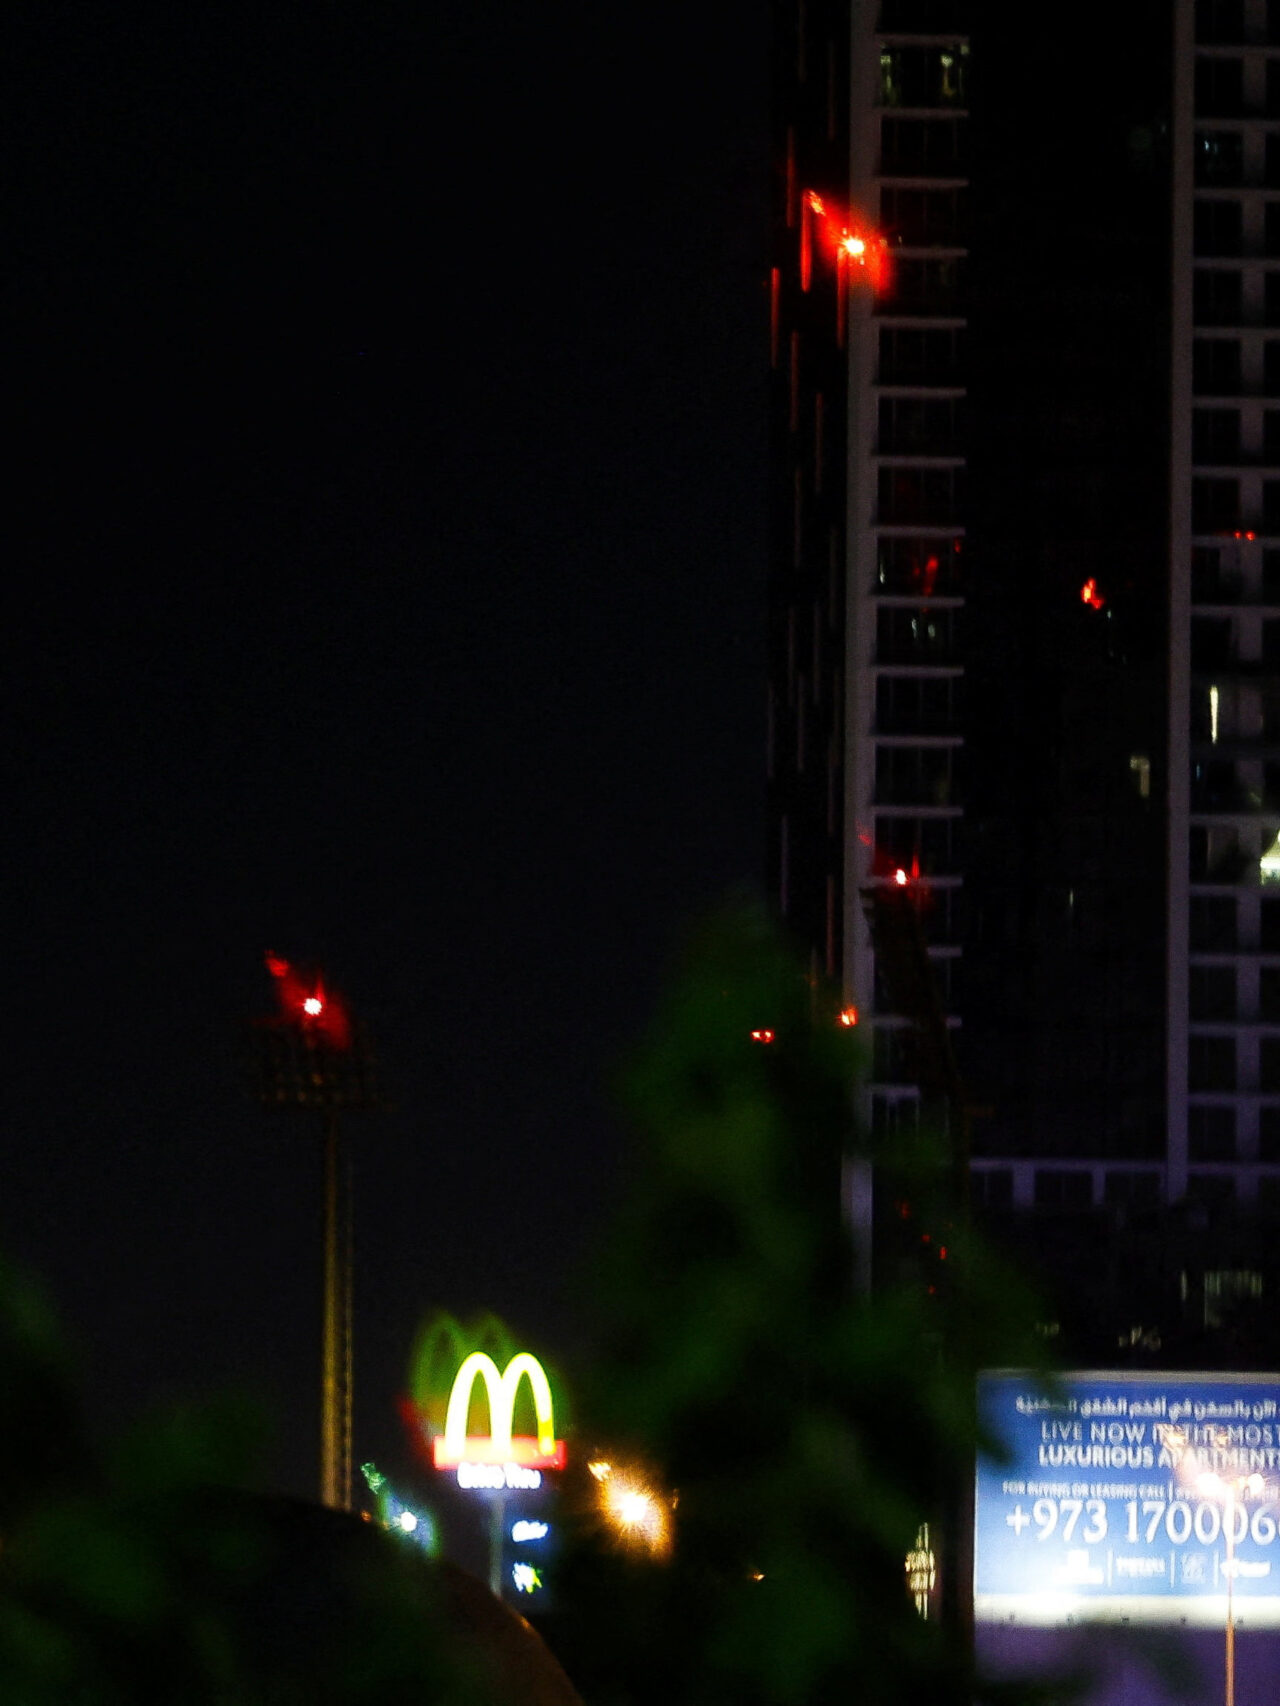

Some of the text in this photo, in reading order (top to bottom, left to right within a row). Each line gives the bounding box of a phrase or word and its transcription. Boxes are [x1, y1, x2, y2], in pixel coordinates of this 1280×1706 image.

[1041, 1420, 1083, 1443] LIVE
[1090, 1423, 1146, 1445] NOW
[1038, 1445, 1153, 1469] LUXURIOUS
[1006, 1498, 1108, 1543] +973
